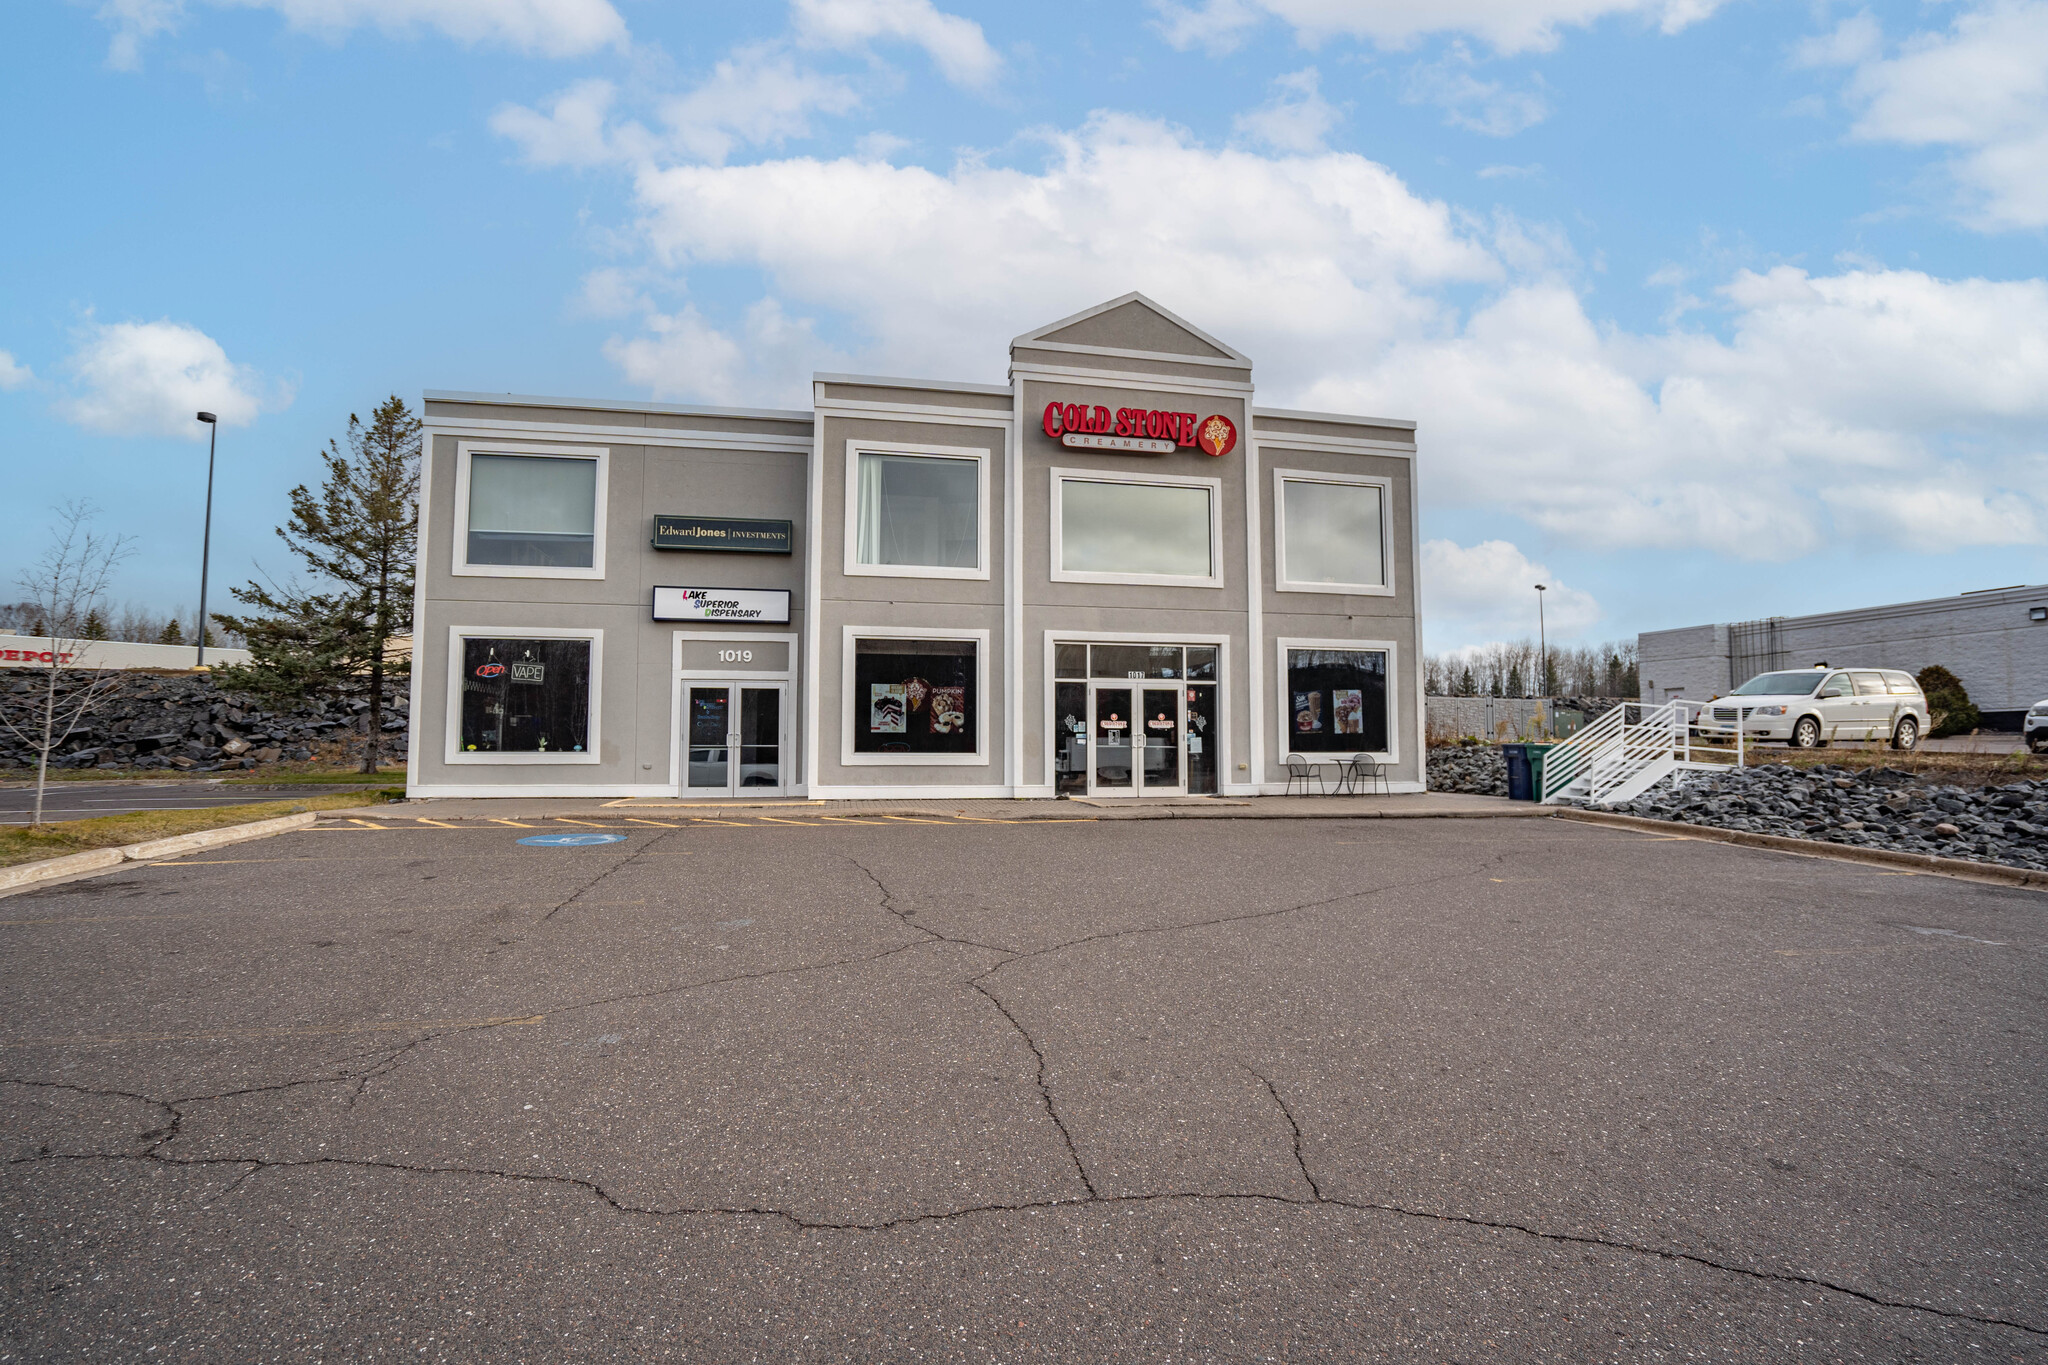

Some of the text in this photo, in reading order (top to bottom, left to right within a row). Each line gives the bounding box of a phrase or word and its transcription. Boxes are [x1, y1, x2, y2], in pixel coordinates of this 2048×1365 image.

[1043, 401, 1198, 447] COLD STONE
[1069, 436, 1170, 450] CREAMERY
[732, 530, 786, 540] INVESTMENTS
[682, 590, 708, 600] LAKE
[693, 600, 740, 609] SUPERIOR
[704, 608, 762, 618] DISPENSARY
[0, 649, 74, 664] EPOT
[718, 649, 753, 662] 1019
[476, 664, 505, 676] Open
[512, 666, 541, 680] VAPE
[932, 687, 963, 695] PUMPKIN
